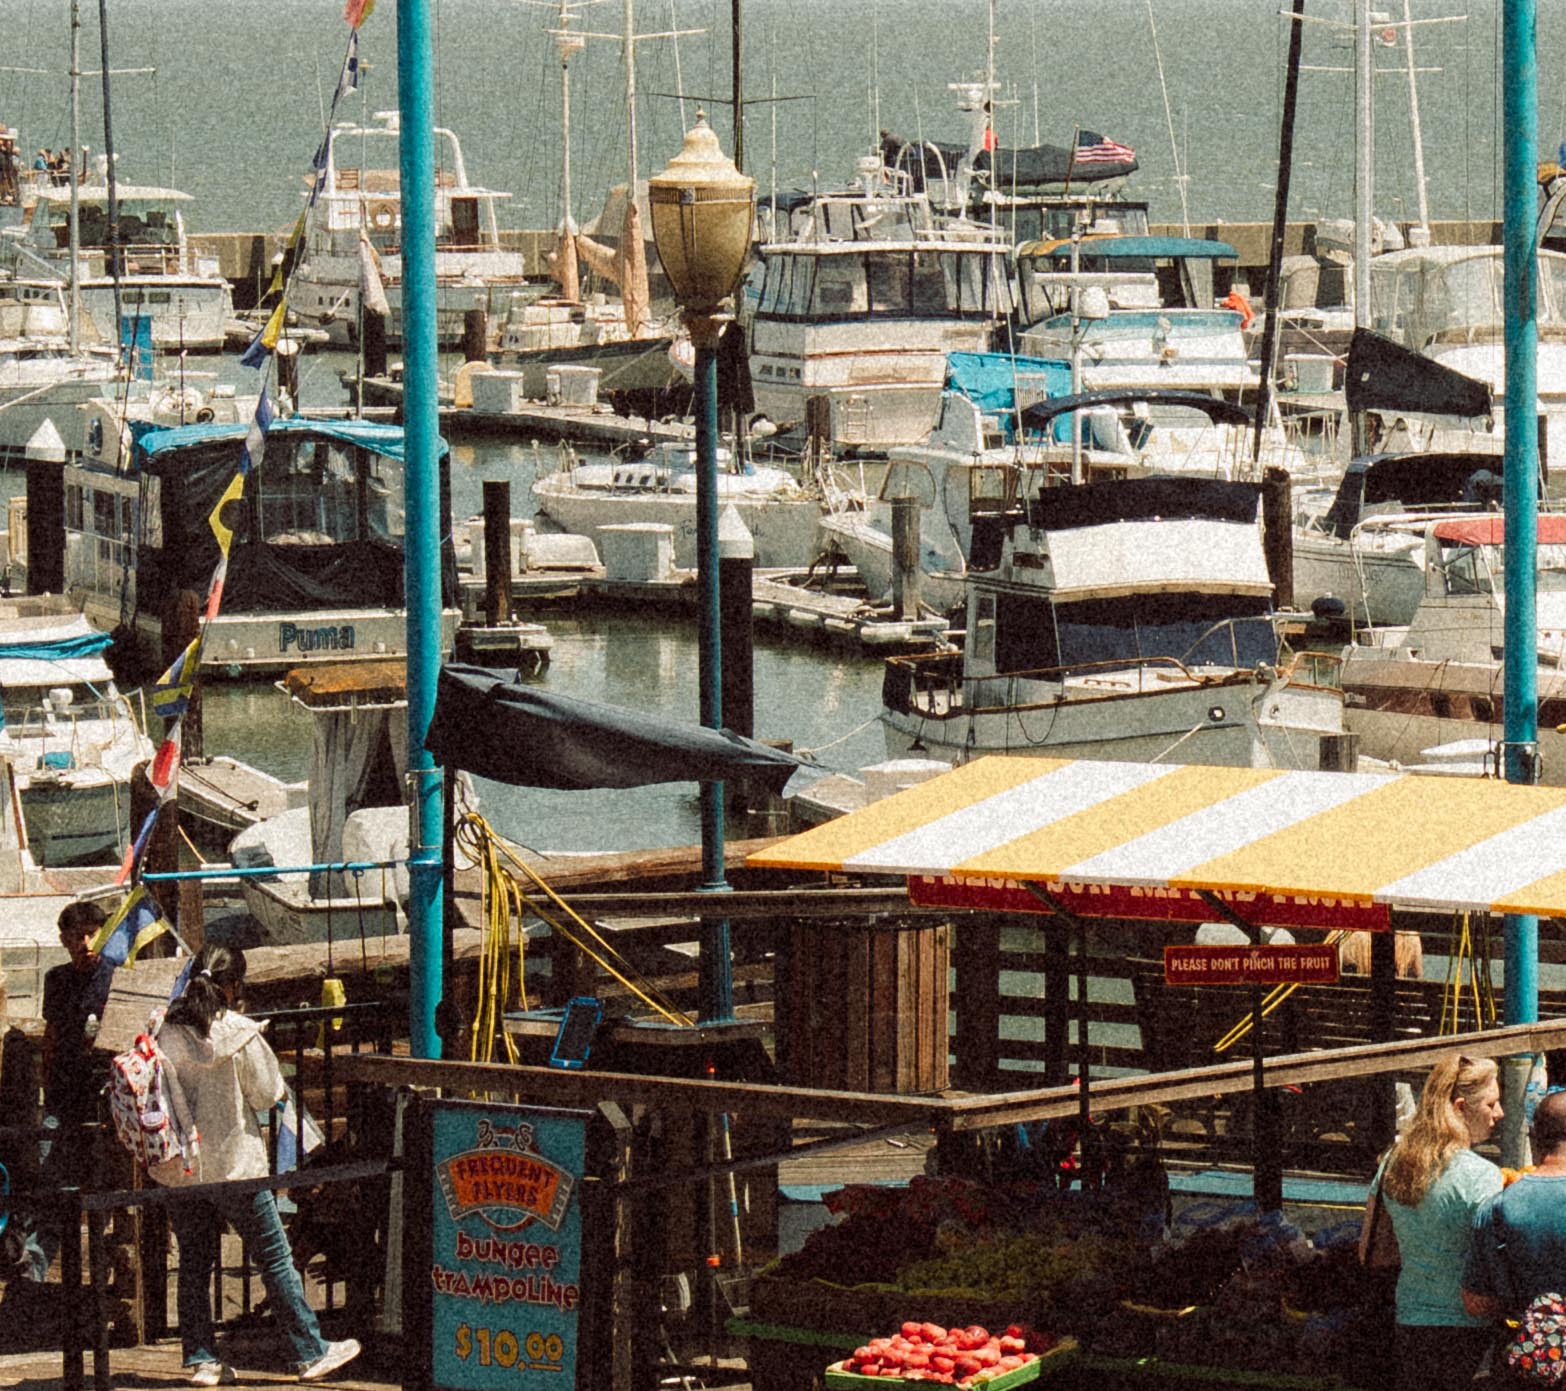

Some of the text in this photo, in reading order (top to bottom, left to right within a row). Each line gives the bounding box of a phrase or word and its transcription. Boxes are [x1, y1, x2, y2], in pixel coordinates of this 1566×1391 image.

[279, 623, 355, 652] Puma
[1171, 956, 1330, 971] PLEASE DON'T PINCH THE FRUIT
[456, 1155, 554, 1187] FREQUENT
[473, 1180, 537, 1206] FLYERS
[455, 1323, 565, 1372] $10.00
